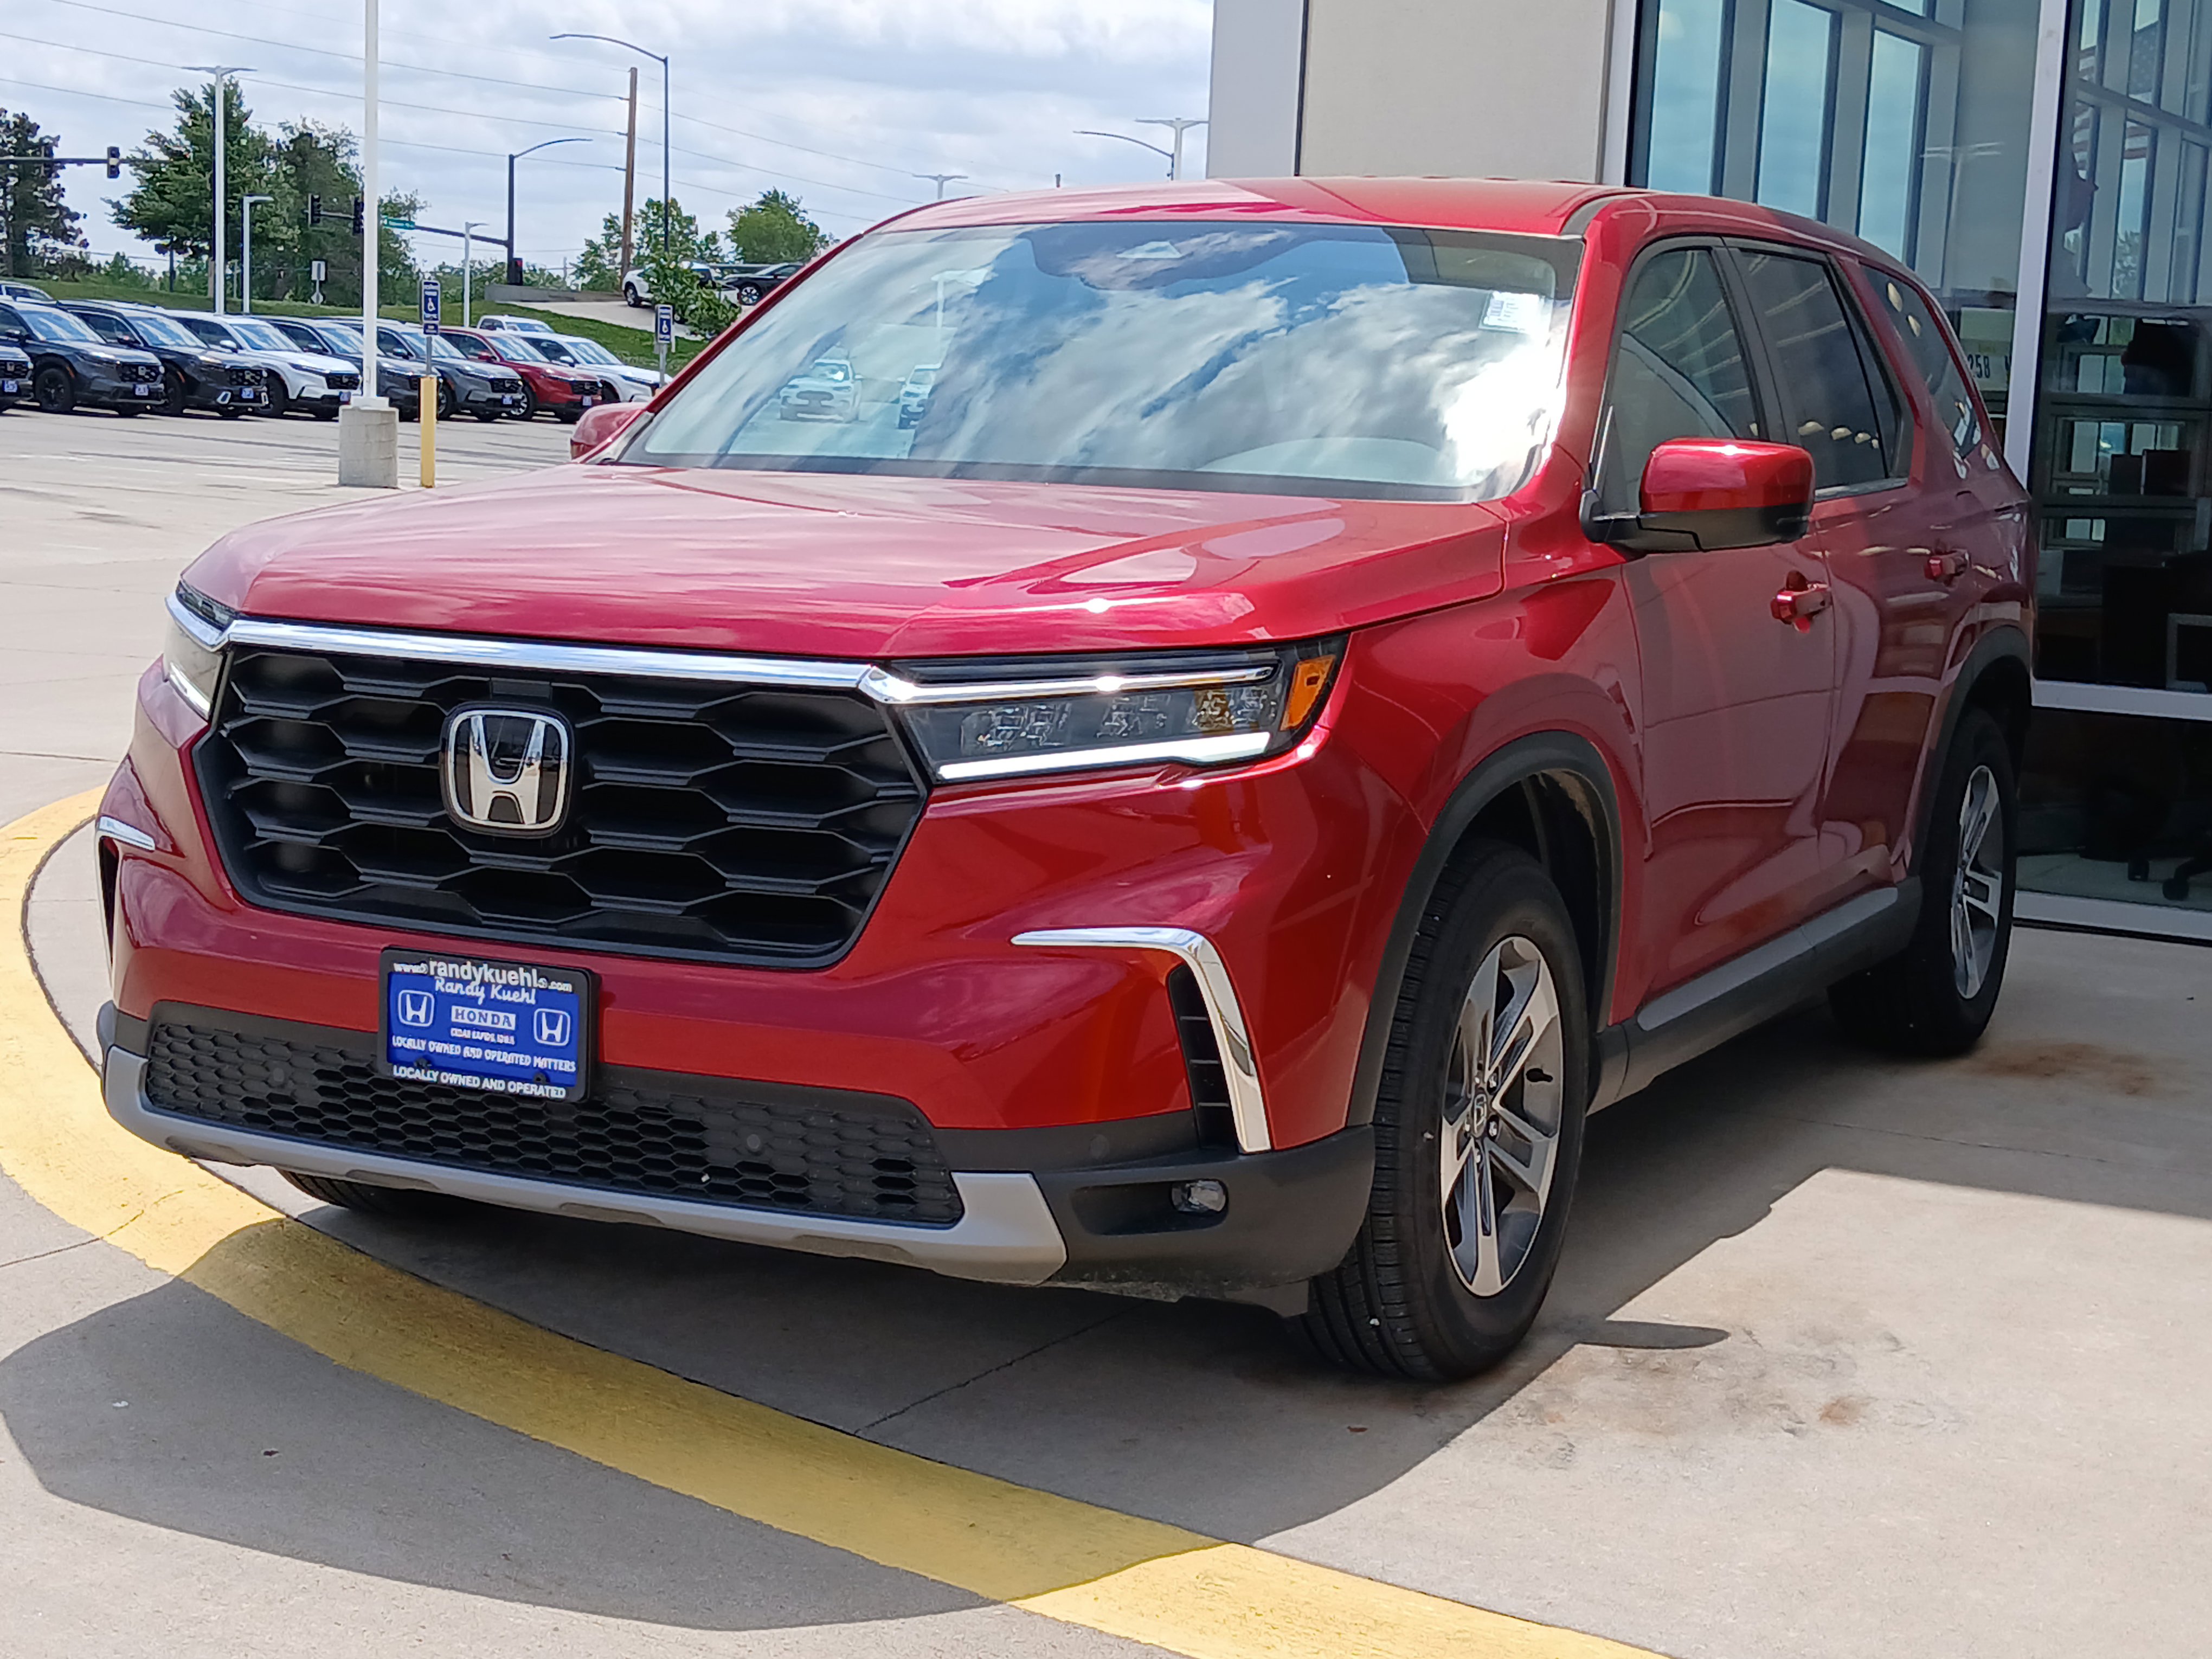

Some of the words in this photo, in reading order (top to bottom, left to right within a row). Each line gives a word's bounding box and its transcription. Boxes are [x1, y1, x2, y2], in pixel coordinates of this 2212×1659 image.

[434, 976, 485, 1005] Randy
[490, 984, 536, 1005] Kuehl
[454, 1008, 512, 1027] HONDA
[392, 1035, 427, 1051] LOCALLY
[428, 1040, 461, 1054] OWNED
[484, 1049, 531, 1066] OPERATED
[533, 1056, 576, 1072] MATTERS
[393, 1065, 439, 1082] LOCALLY
[440, 1072, 480, 1088] OWNED
[482, 1078, 505, 1090] AND
[507, 1081, 566, 1099] OPERATED
